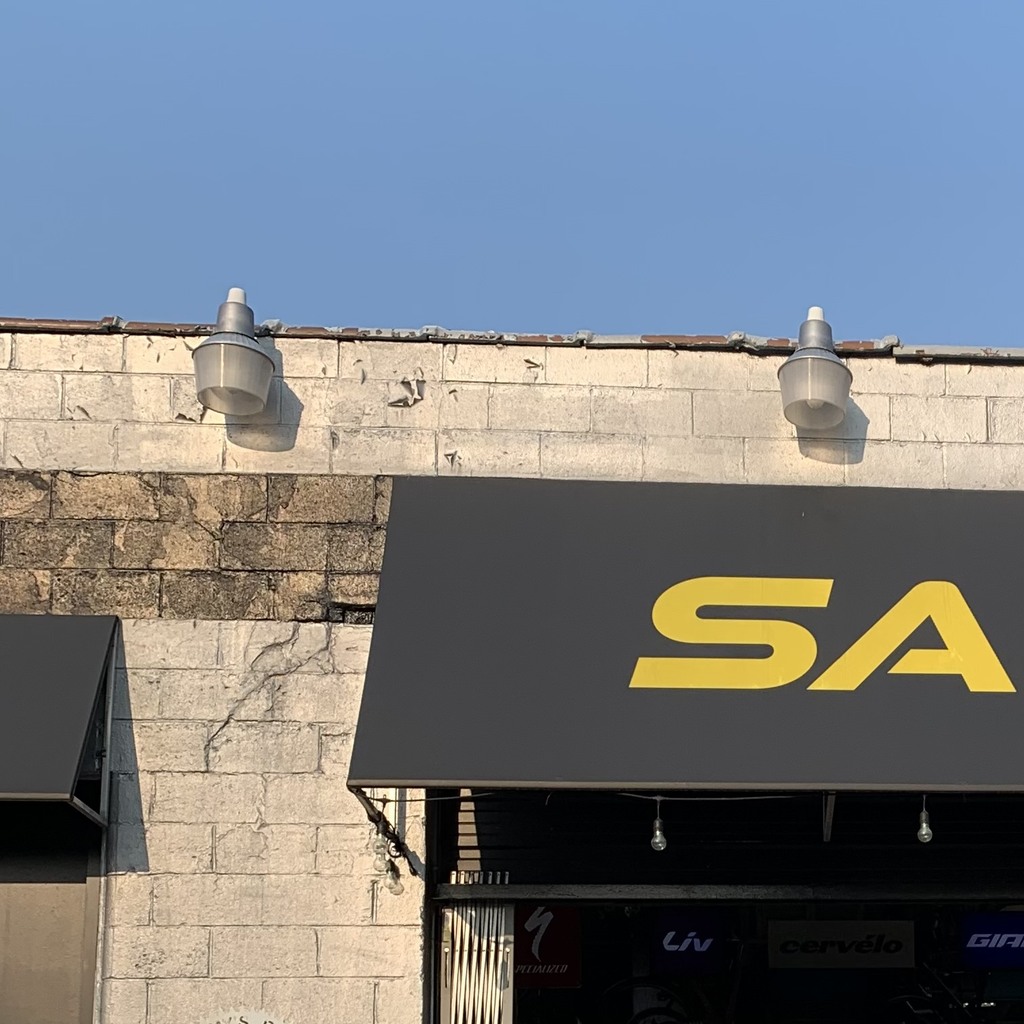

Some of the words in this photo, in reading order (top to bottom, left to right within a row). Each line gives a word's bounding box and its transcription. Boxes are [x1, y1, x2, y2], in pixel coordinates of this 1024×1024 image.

[662, 931, 714, 951] Liv
[779, 933, 903, 954] cervélo
[515, 964, 568, 974] PECIALIZED
